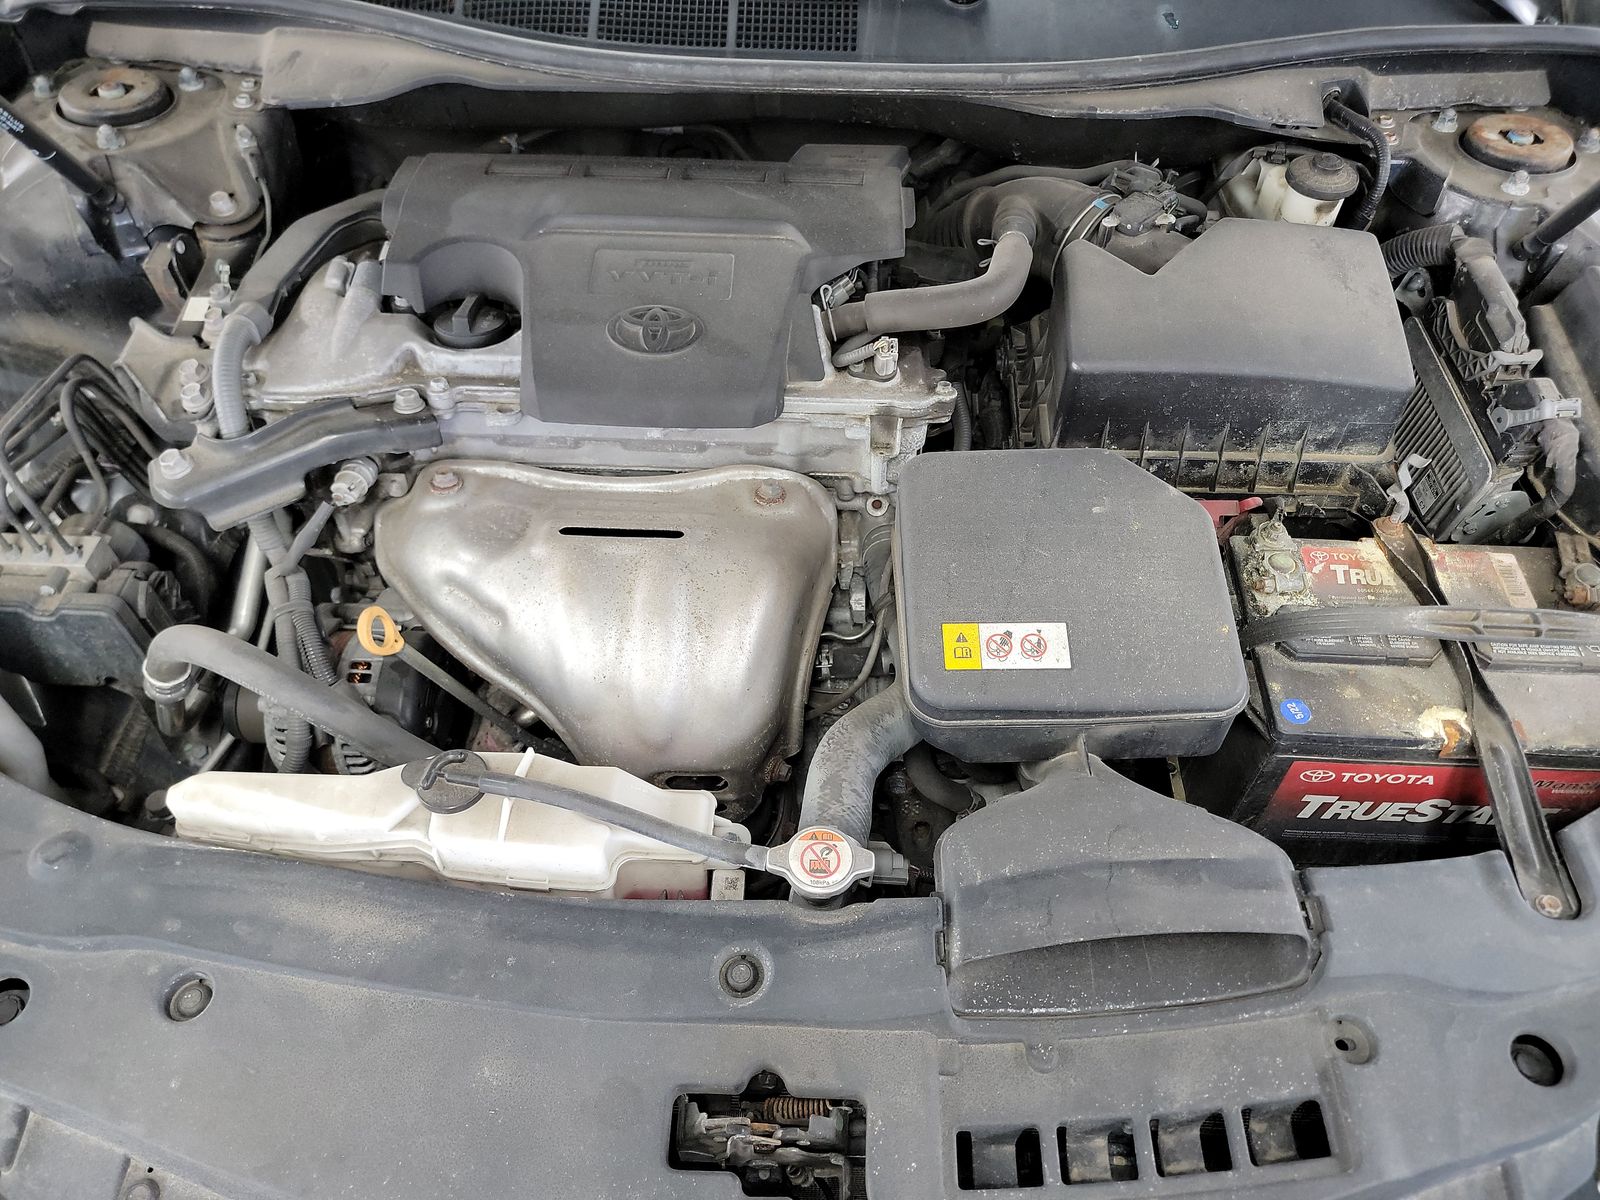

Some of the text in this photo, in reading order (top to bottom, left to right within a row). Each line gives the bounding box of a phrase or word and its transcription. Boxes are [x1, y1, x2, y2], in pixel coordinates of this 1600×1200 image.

[1286, 702, 1305, 720] 5/22
[1341, 772, 1435, 786] TOYOTA
[1296, 794, 1562, 826] TRUESTA
